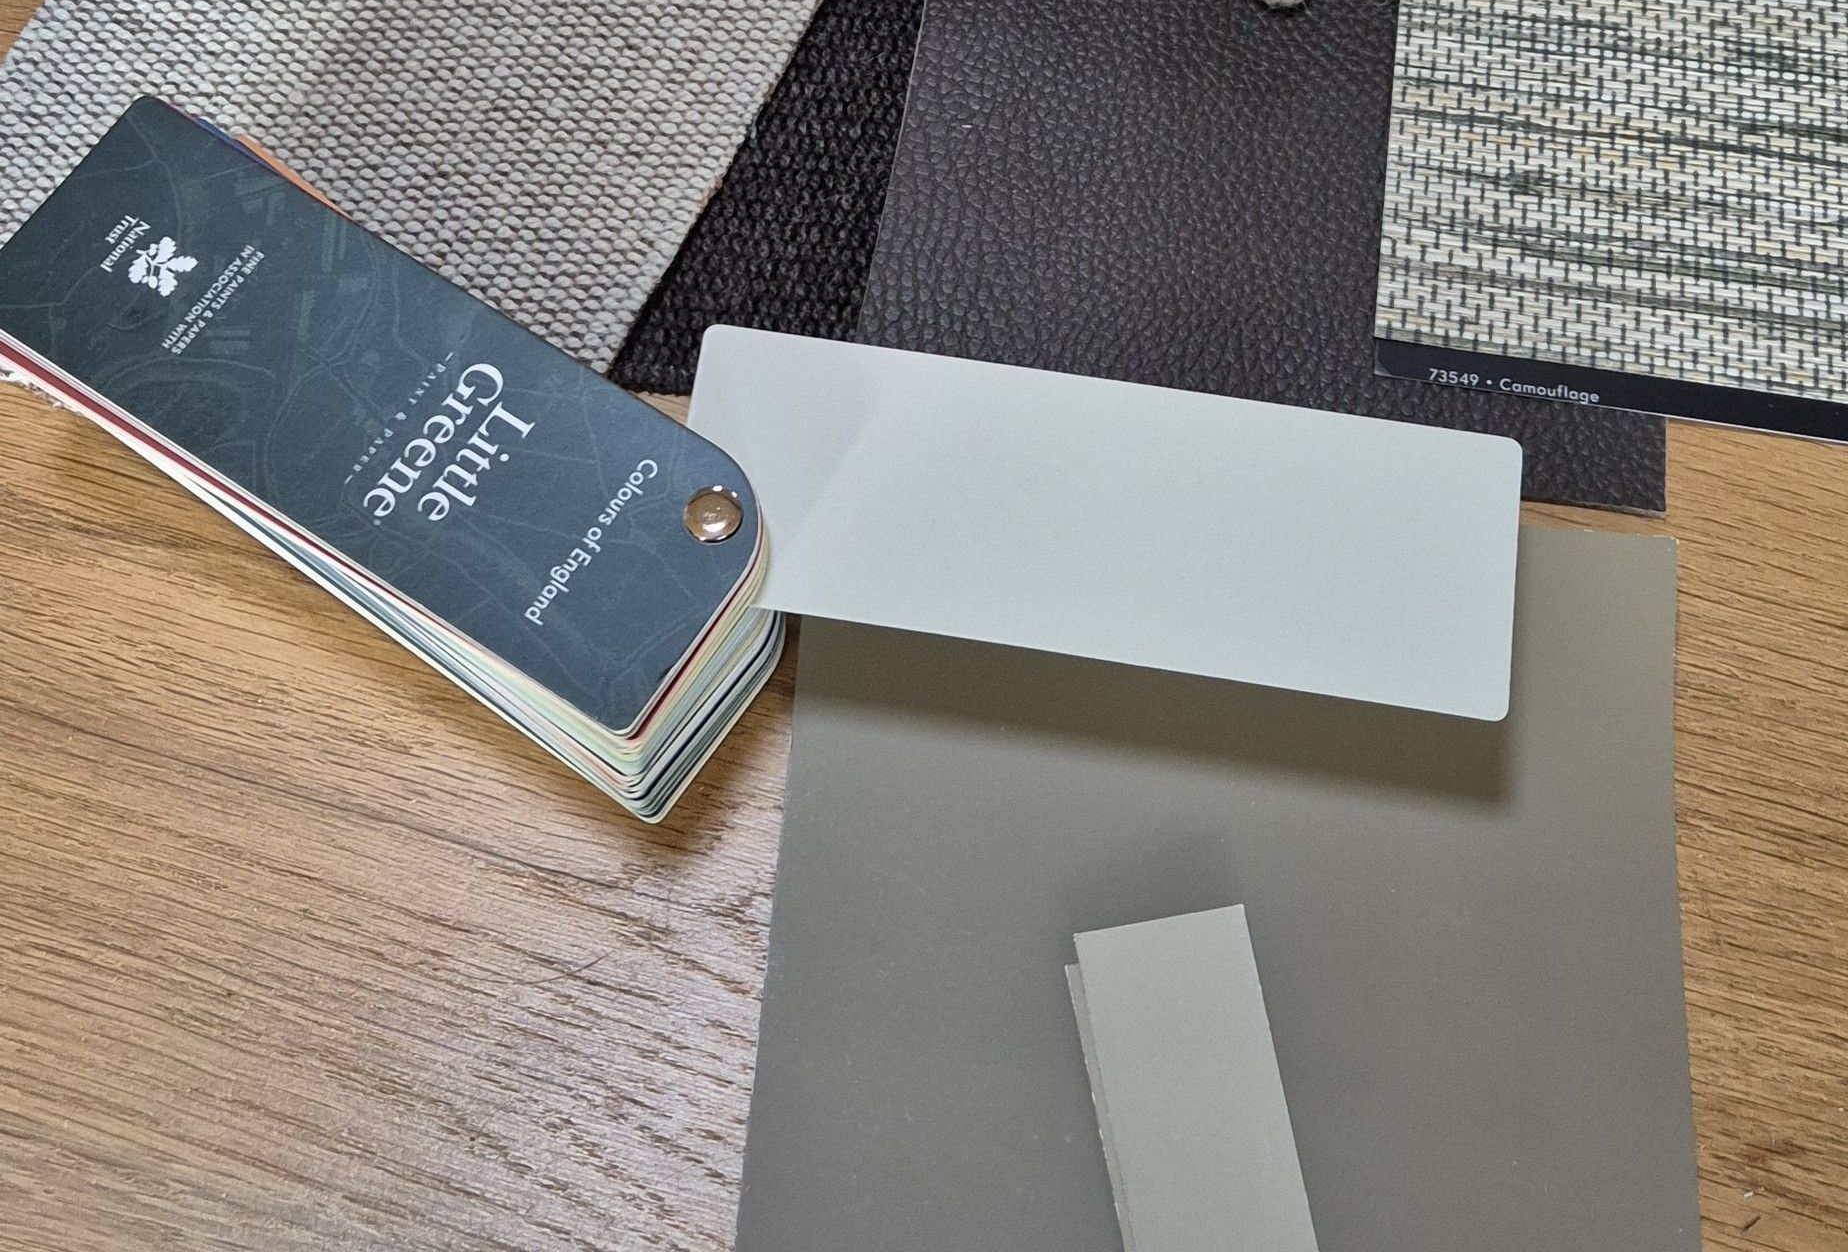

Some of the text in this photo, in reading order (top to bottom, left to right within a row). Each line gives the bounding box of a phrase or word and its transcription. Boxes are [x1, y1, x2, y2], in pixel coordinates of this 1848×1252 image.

[100, 219, 151, 274] National
[105, 214, 139, 245] Trust
[241, 251, 265, 275] FINE
[161, 244, 255, 349] IN ASSOCIATION WITH
[211, 275, 245, 309] PAINTS
[171, 319, 206, 355] PAPERS
[1428, 368, 1600, 404] 73549 Camouflage
[363, 363, 505, 518] Greene
[417, 401, 536, 522] Little
[524, 459, 659, 626] Colours of England
